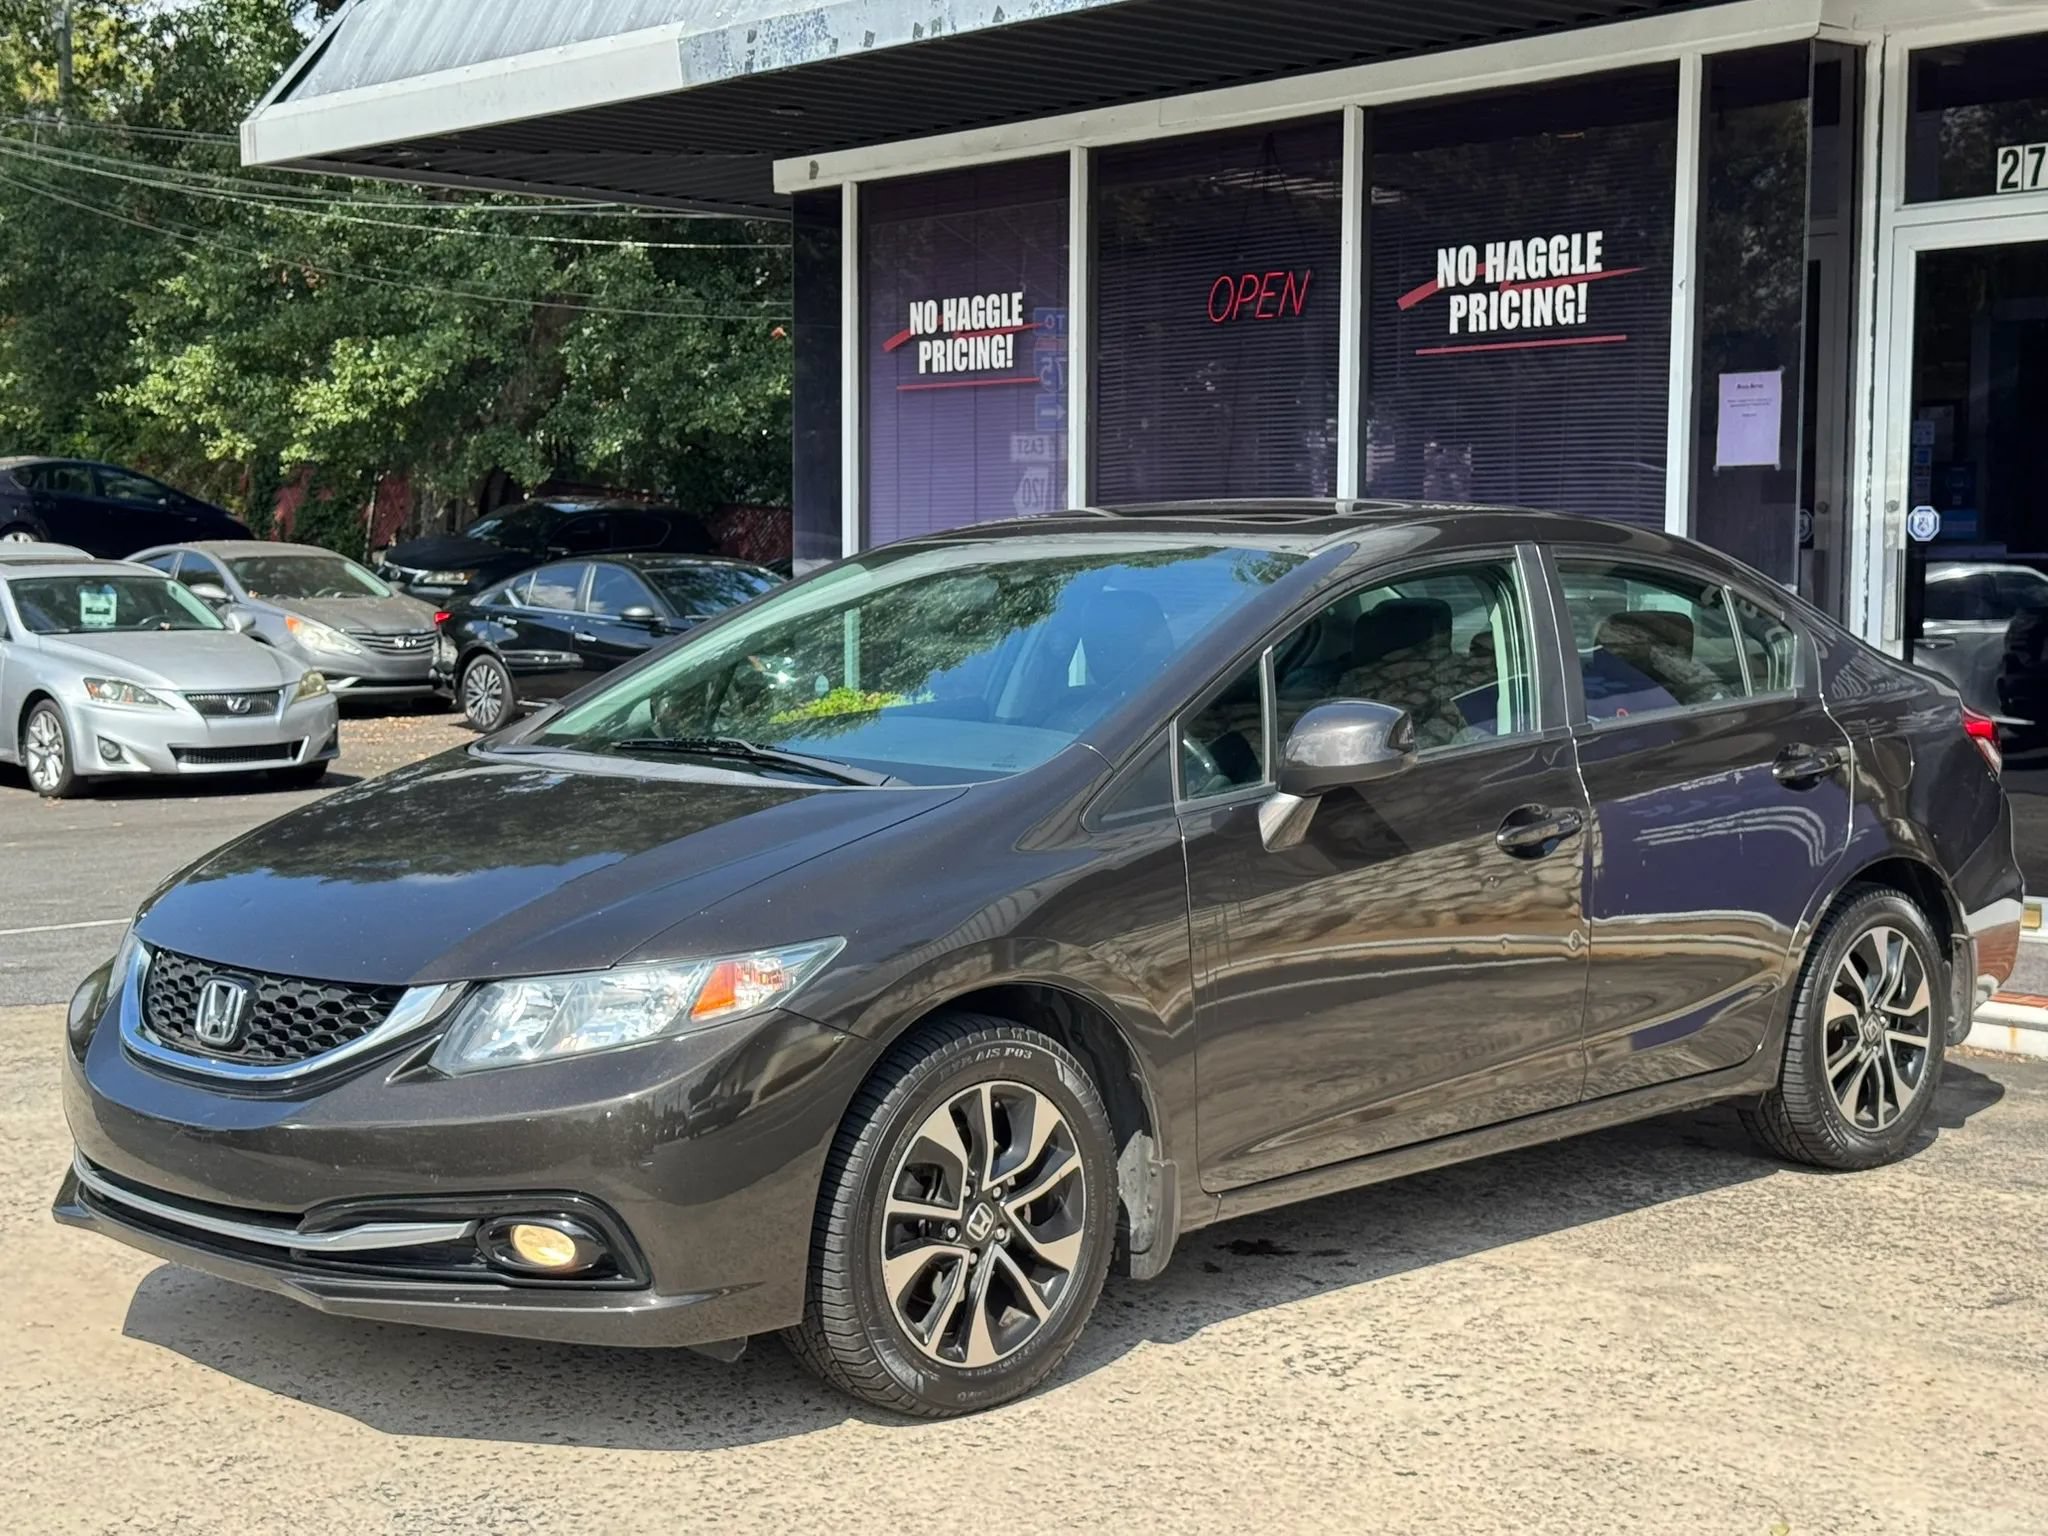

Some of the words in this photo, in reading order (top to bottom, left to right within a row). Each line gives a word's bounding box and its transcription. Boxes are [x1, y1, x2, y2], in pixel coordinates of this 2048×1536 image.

[2000, 146, 2047, 190] 27
[1437, 244, 1477, 289] NO
[1485, 230, 1603, 284] HAGGLE
[909, 299, 938, 336] NO
[942, 291, 1024, 333] HAGGLE
[1208, 269, 1311, 322] OPEN
[1449, 282, 1588, 335] PRICING!
[918, 333, 1014, 375] PRICING!
